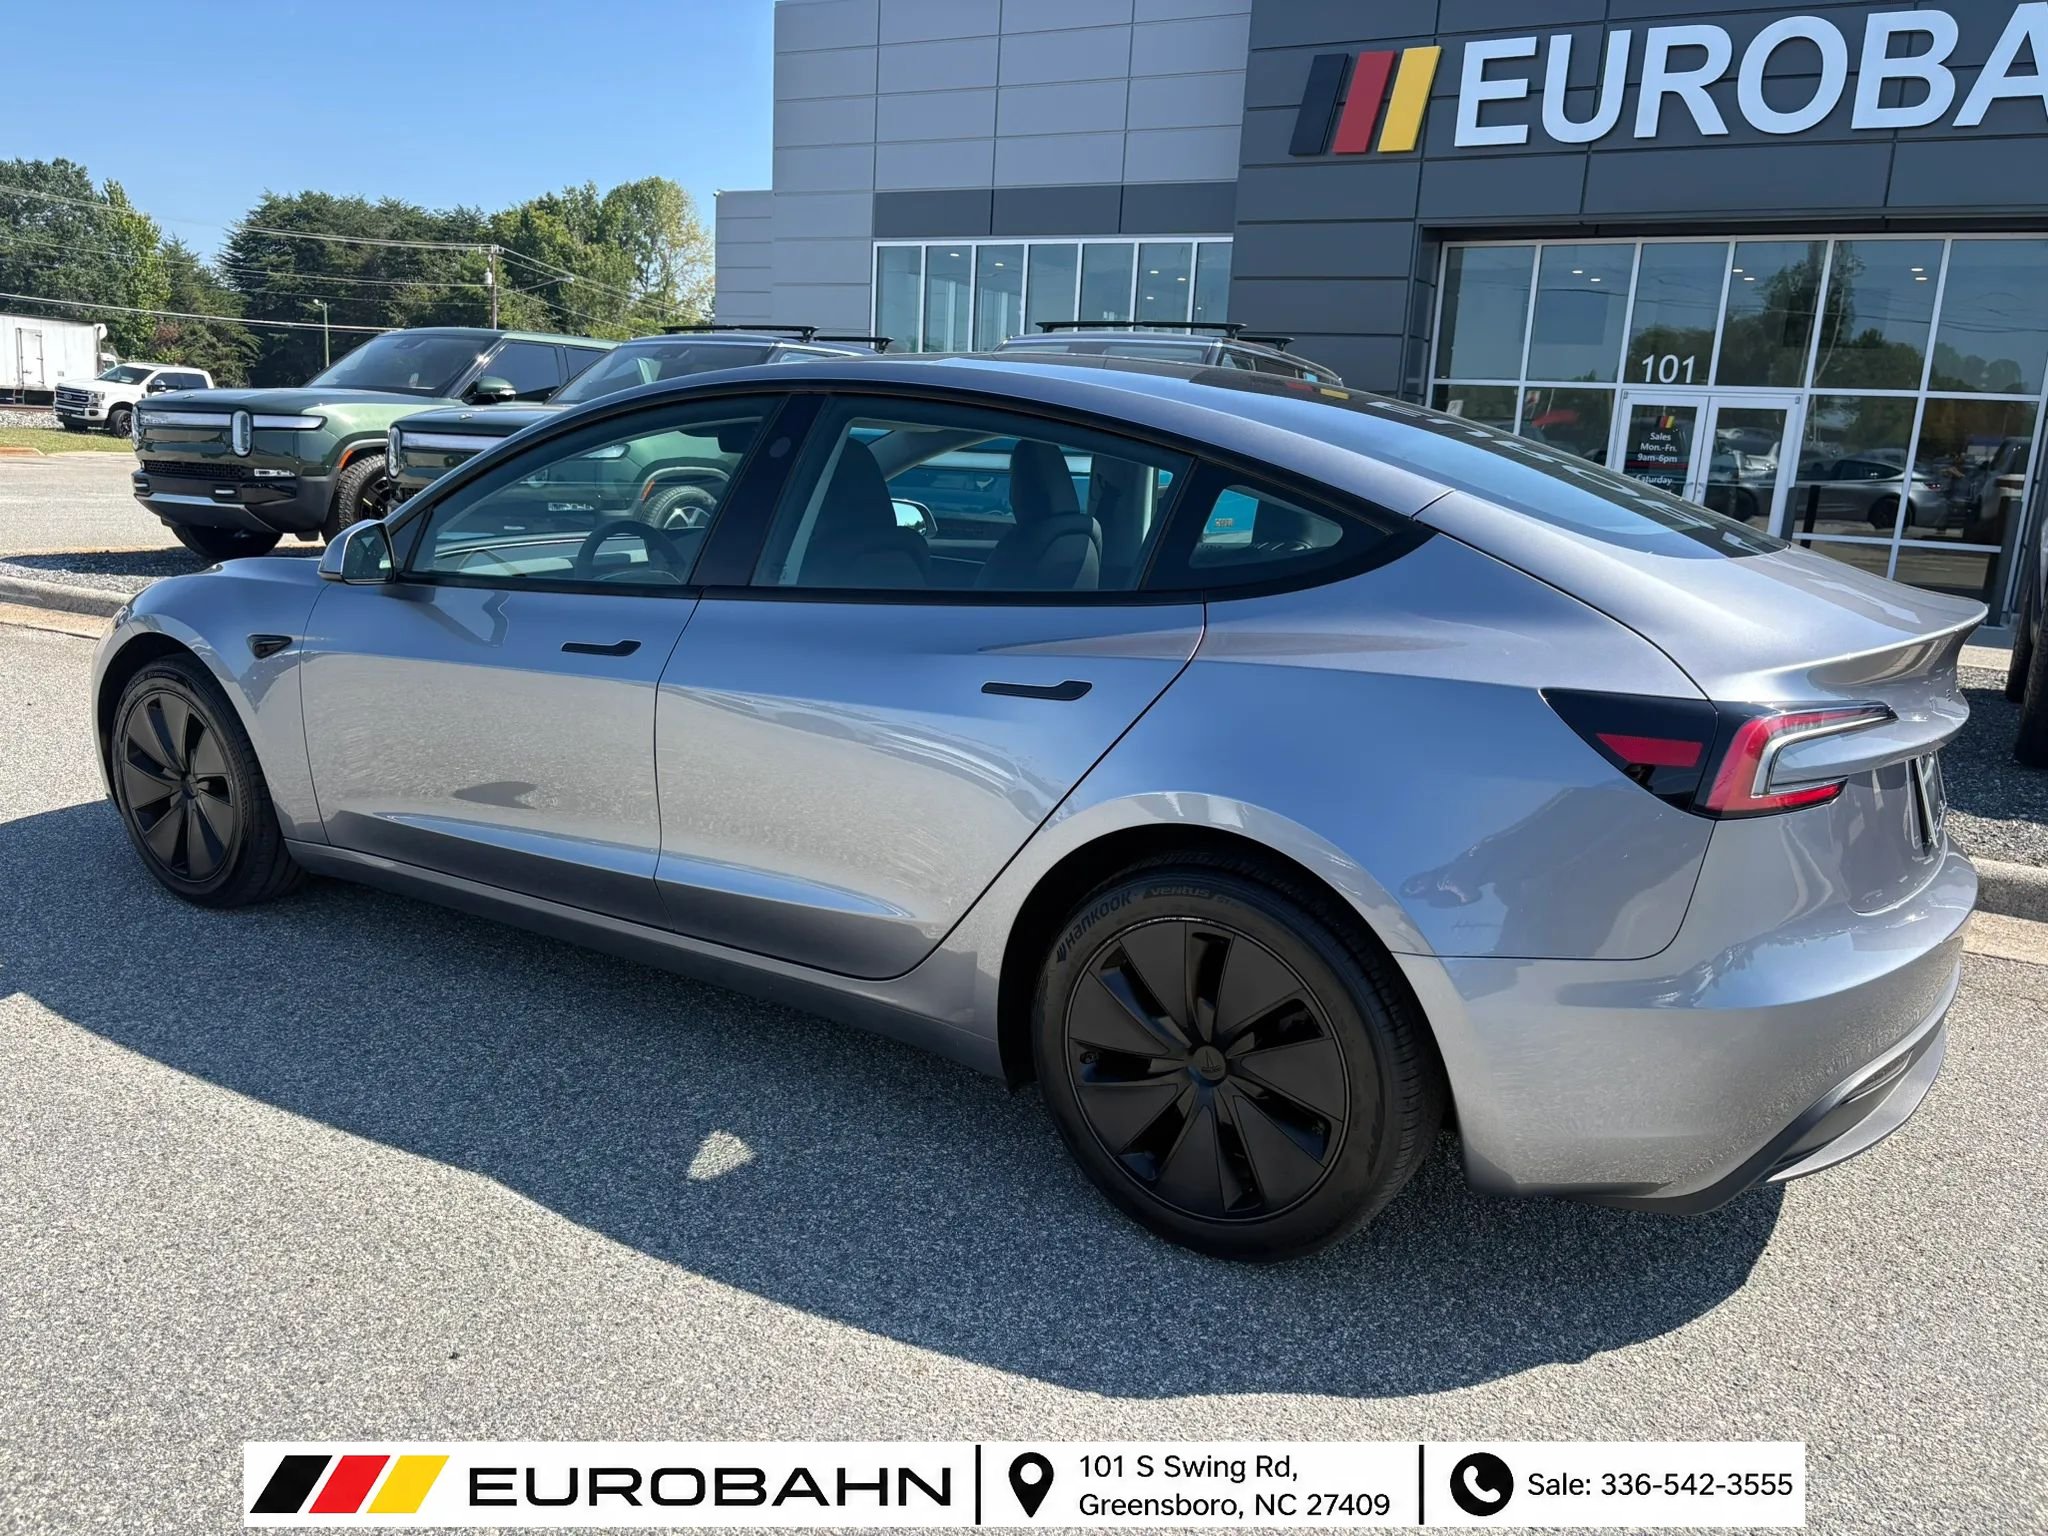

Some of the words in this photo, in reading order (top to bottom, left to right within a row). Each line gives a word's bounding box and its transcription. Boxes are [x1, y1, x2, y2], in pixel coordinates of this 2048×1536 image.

[1641, 354, 1696, 384] 101
[1649, 432, 1671, 441] Sales
[1637, 453, 1678, 464] 9am-6pm
